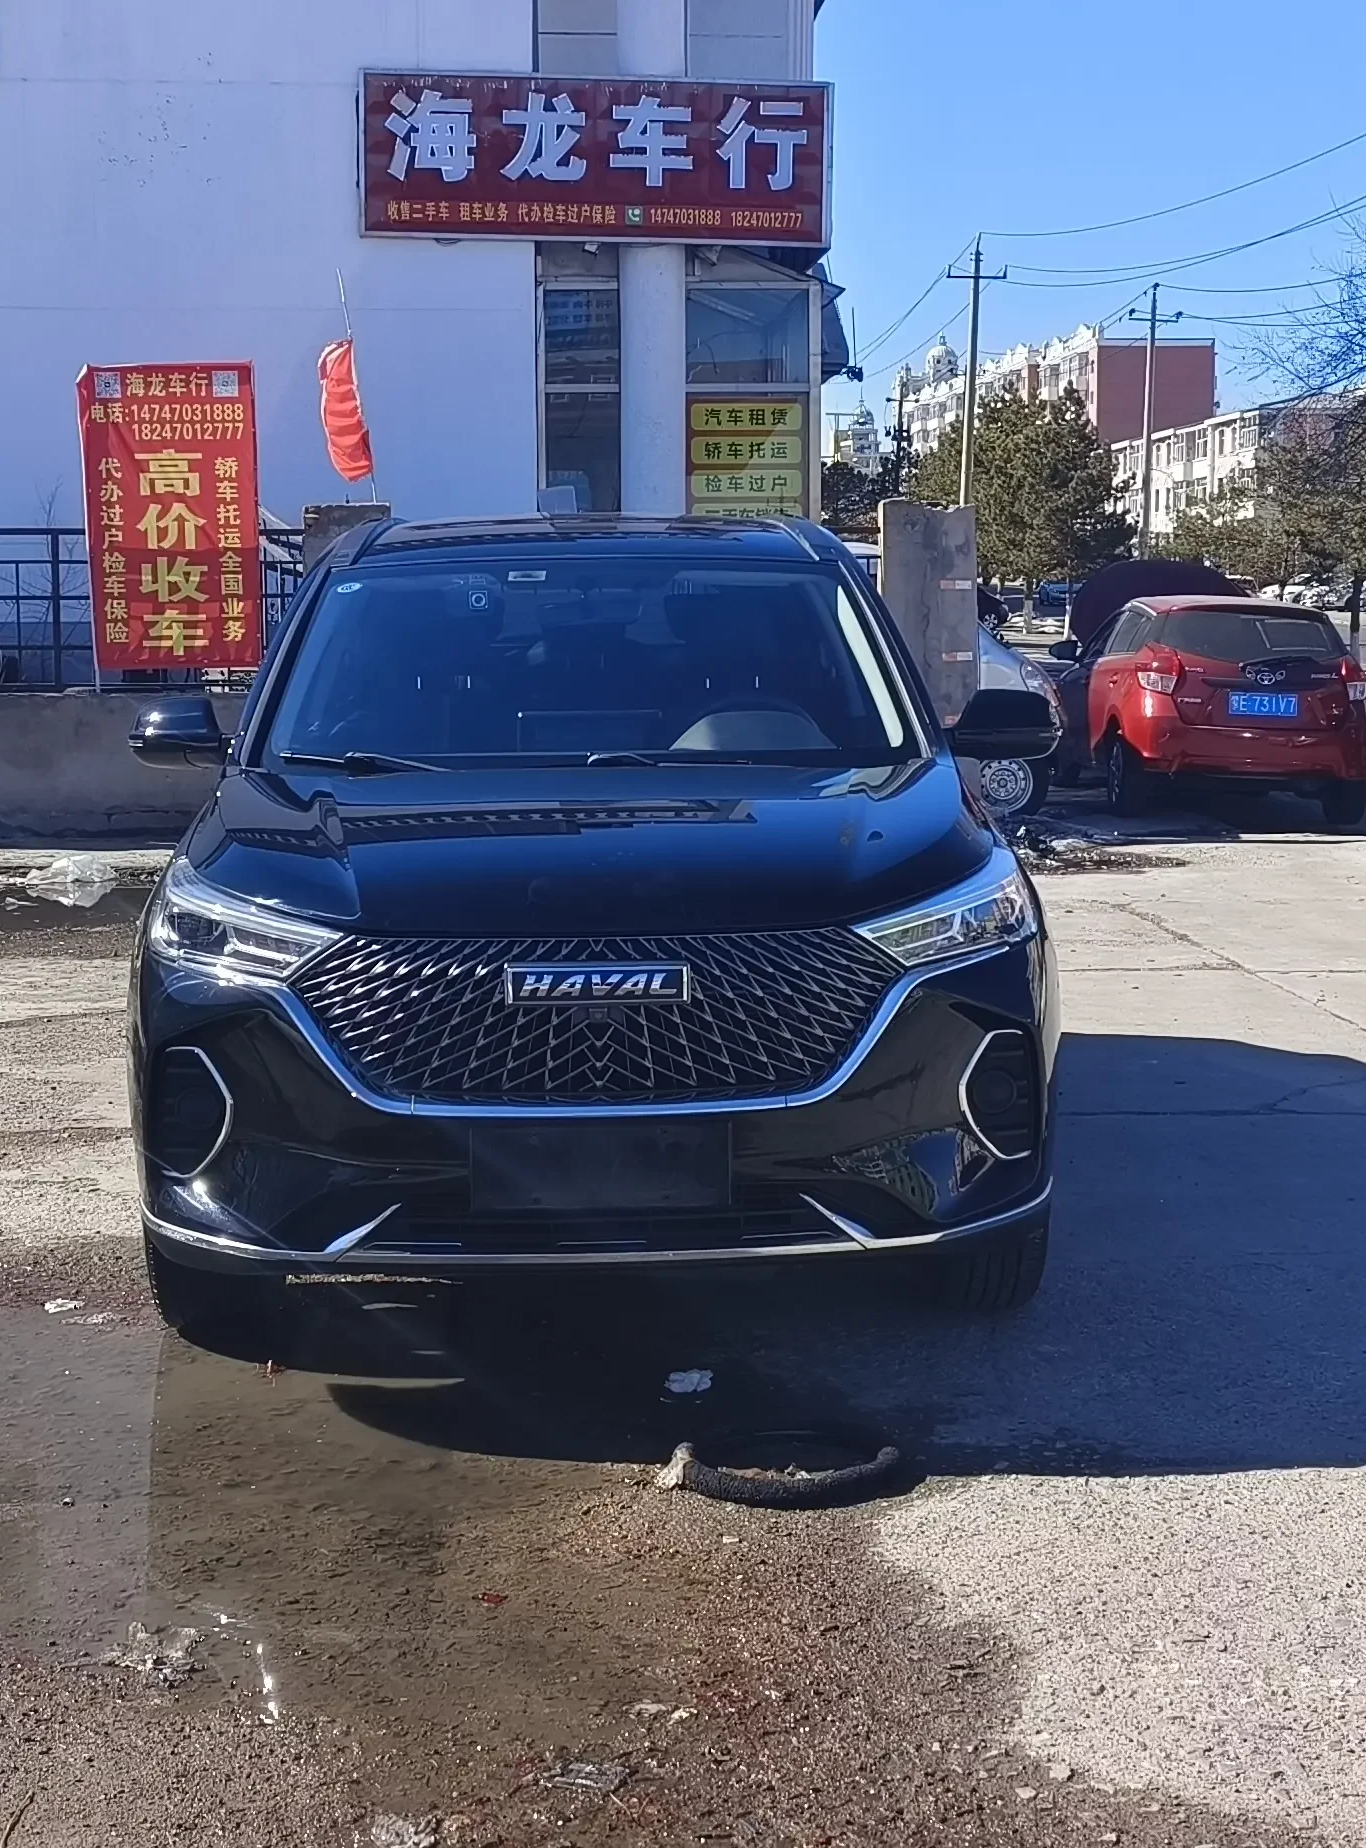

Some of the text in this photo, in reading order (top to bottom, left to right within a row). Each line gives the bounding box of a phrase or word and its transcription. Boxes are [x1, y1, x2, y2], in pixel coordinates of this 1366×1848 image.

[384, 90, 808, 190] 海龙车行
[387, 201, 802, 229] 收售二手车 租车业务 代办检车过户保险 14747031888 18247012777
[125, 372, 208, 398] 海龙车行
[91, 403, 244, 424] 电话:14747031888
[704, 408, 788, 426] 汽车租赁
[132, 423, 244, 441] 18247012777
[704, 441, 788, 460] 轿车托运
[704, 475, 788, 493] 检车过户
[98, 457, 130, 645] 代办过户检车保险
[134, 448, 211, 656] 高价收车
[214, 456, 247, 643] 轿车托运全国业务
[519, 973, 678, 997] HAVAL
